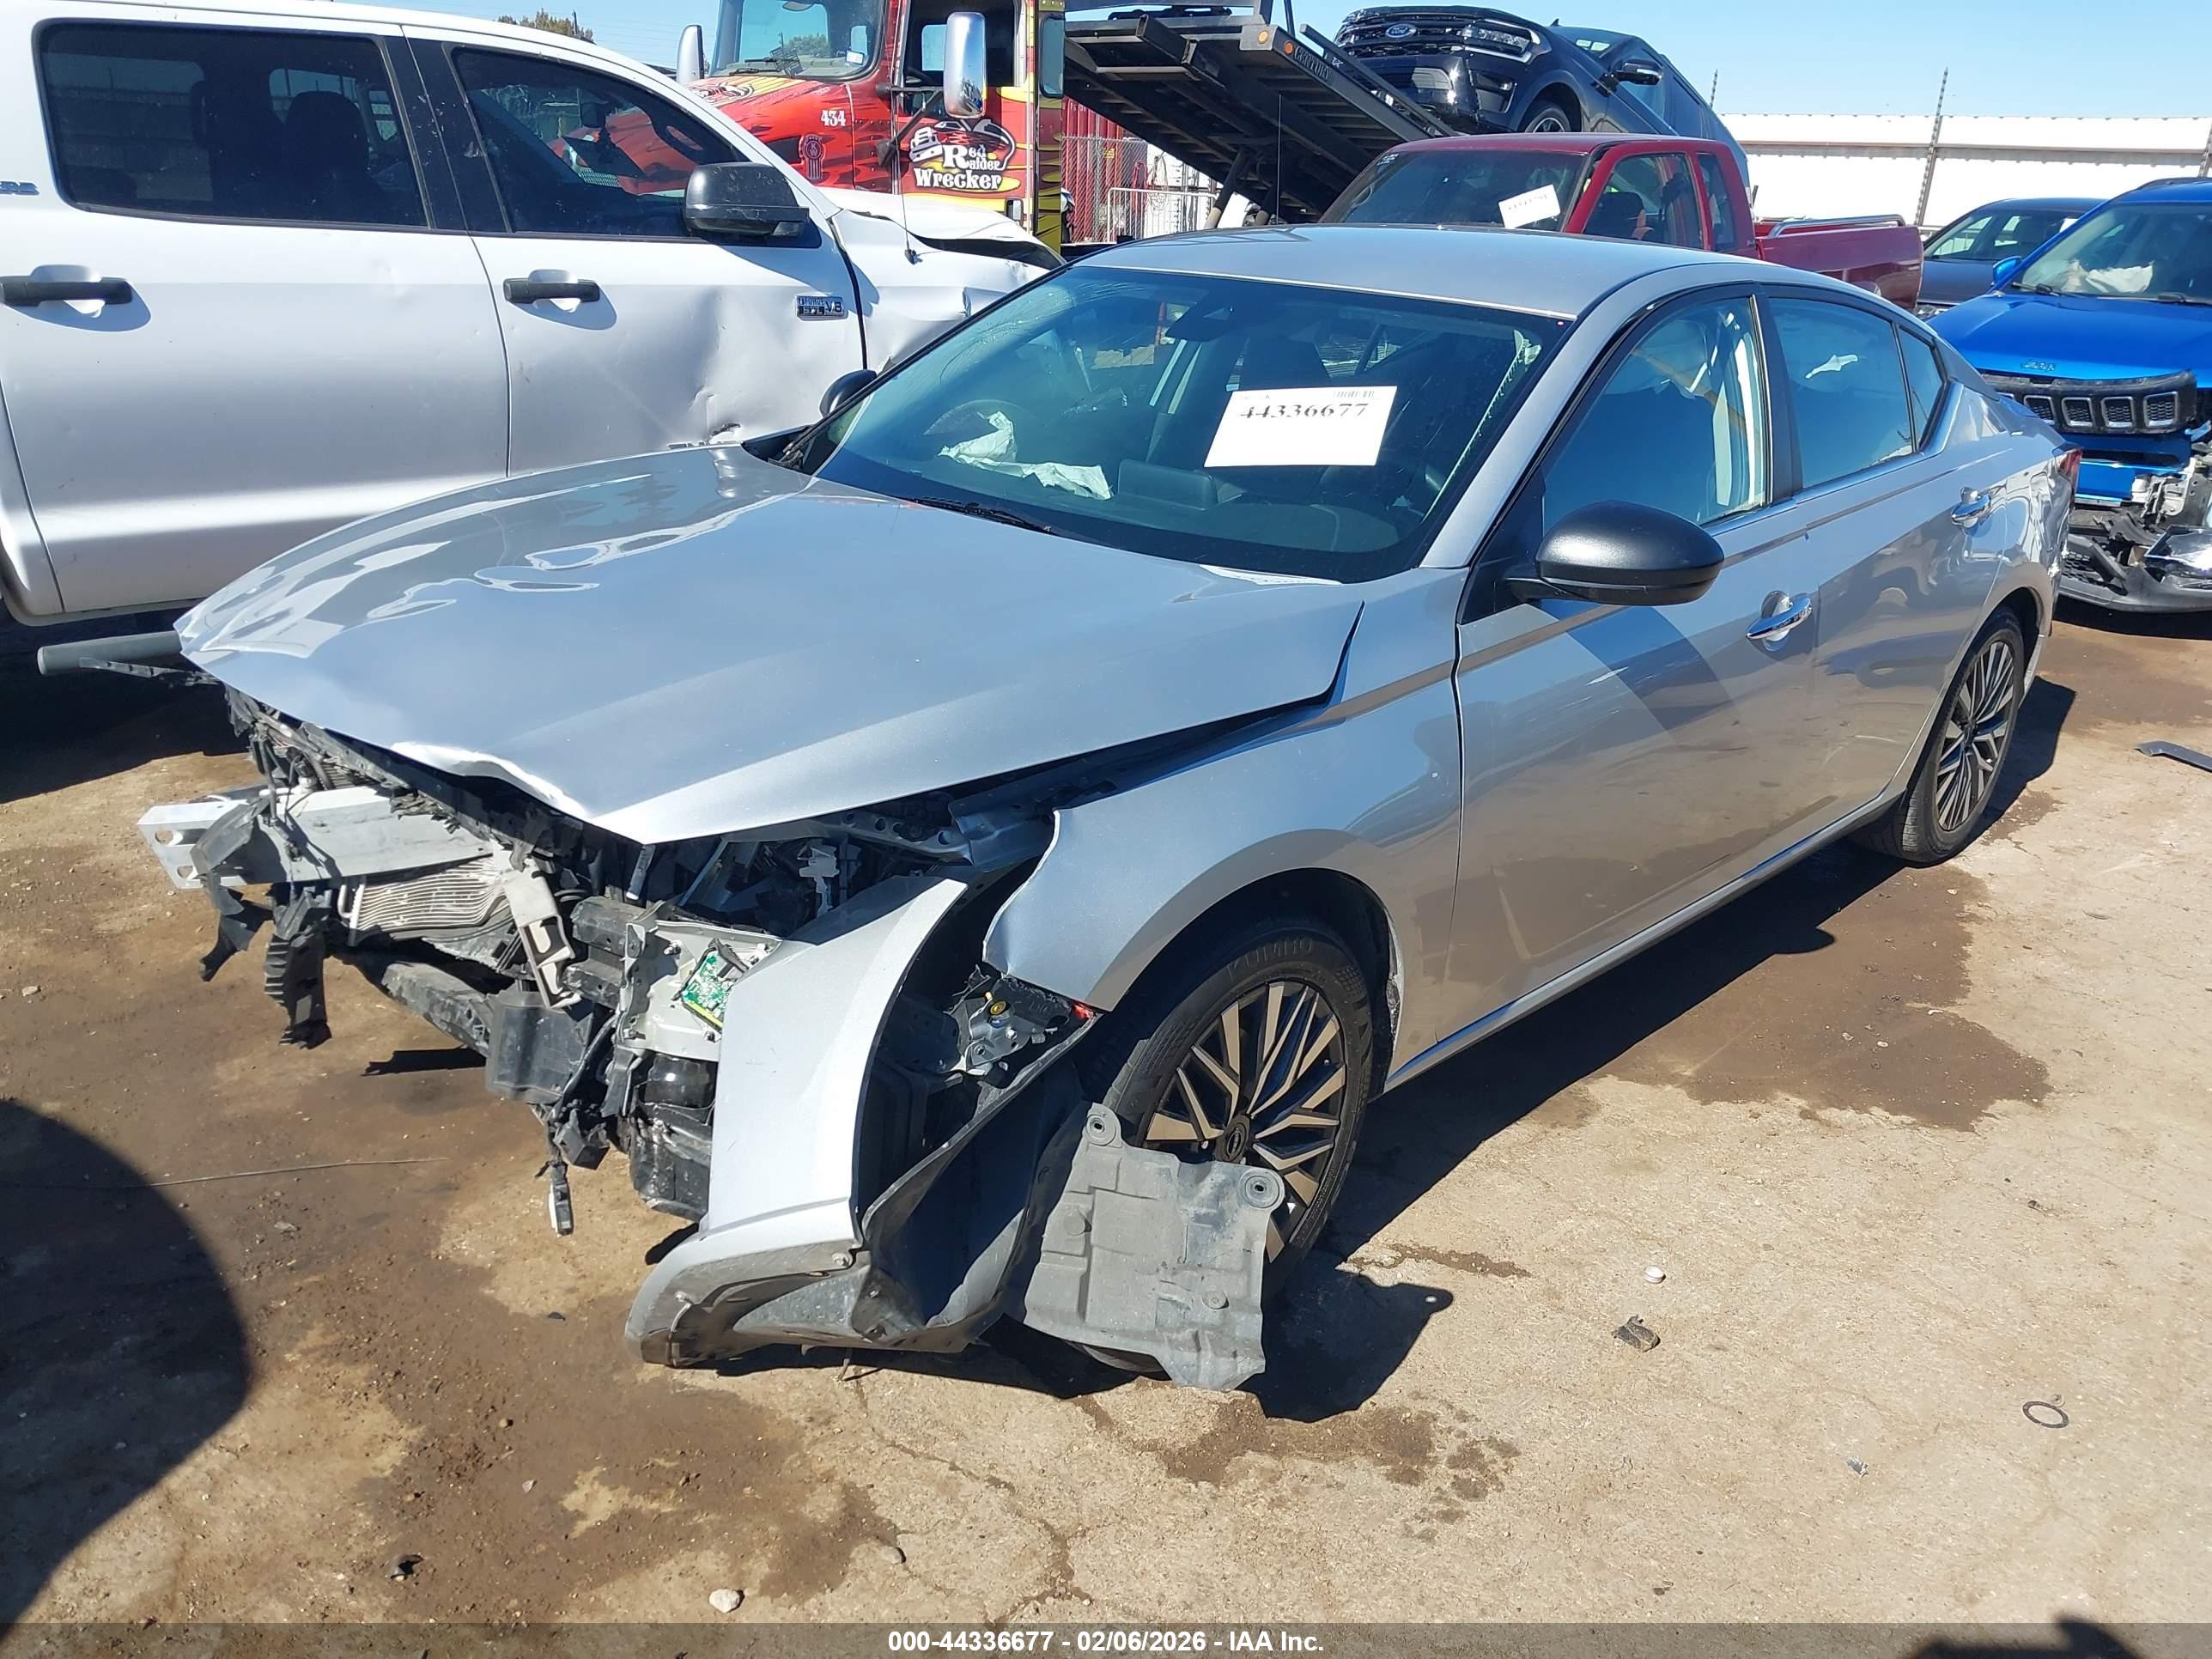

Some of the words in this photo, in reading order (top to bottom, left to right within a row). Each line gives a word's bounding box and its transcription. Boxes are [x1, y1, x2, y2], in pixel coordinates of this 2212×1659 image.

[821, 110, 846, 126] 434
[914, 167, 1003, 189] Wrecker
[825, 301, 842, 313] V8
[1239, 403, 1369, 419] 44336677
